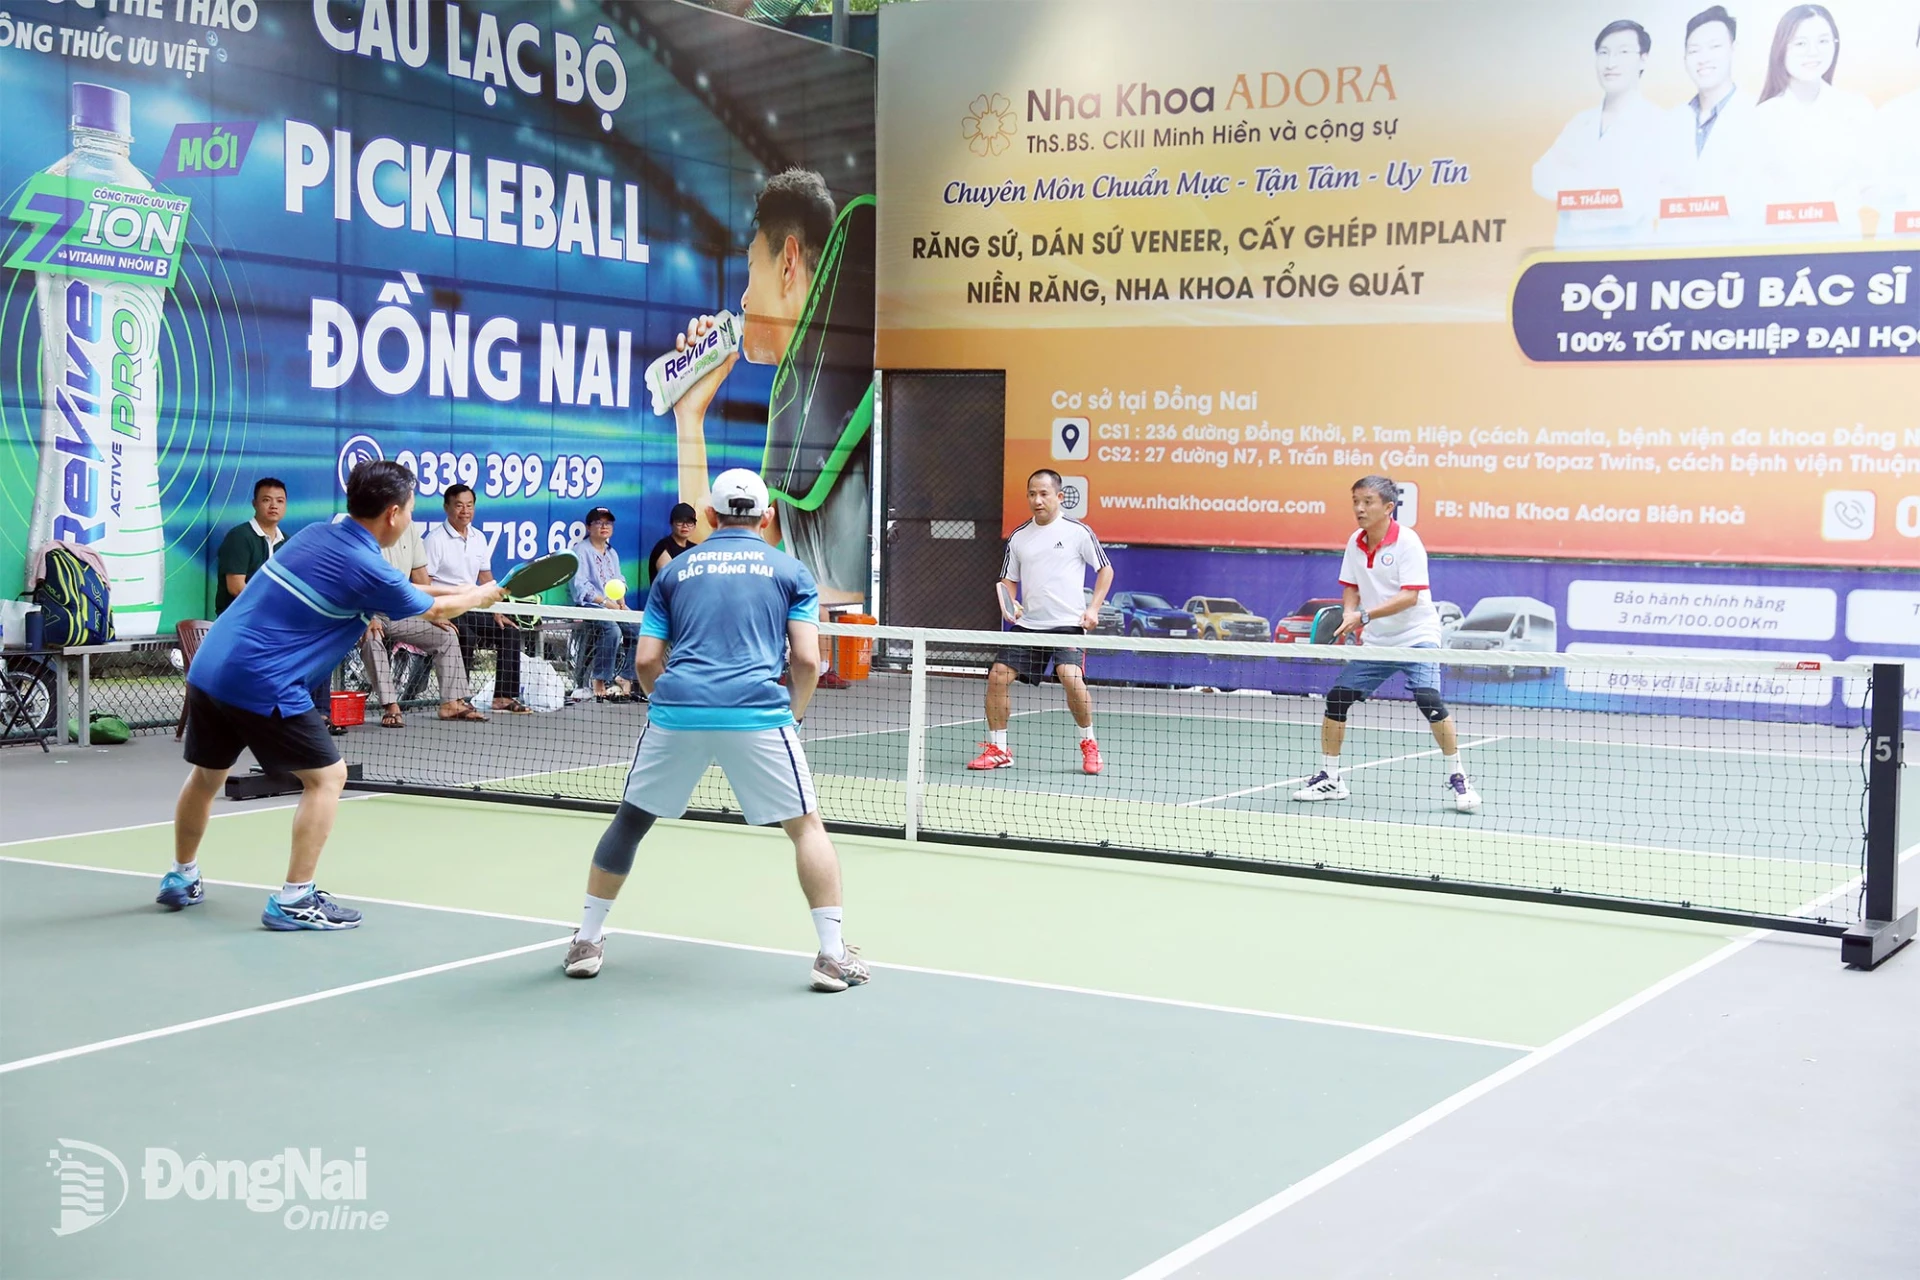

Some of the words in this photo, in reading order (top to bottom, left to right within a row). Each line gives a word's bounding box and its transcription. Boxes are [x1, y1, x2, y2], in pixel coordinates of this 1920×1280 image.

[59, 26, 123, 62] THỨC
[128, 37, 157, 66] ƯU
[163, 39, 210, 79] VIỆT
[447, 4, 542, 106] LẠC
[555, 24, 627, 131] BỘ
[1027, 88, 1101, 122] Nha
[1116, 82, 1215, 117] Khoa
[1225, 64, 1397, 111] ADORA
[177, 127, 238, 172] MỚI
[1027, 132, 1095, 154] ThS.BS.
[1103, 130, 1145, 150] CKII
[1154, 127, 1204, 147] Minh
[1213, 120, 1261, 144] Hiền
[1269, 119, 1296, 141] và
[1305, 119, 1364, 143] cộng
[1372, 118, 1398, 140] sự
[94, 187, 121, 201] CÔNG
[124, 194, 149, 206] THỨC
[167, 200, 187, 213] VIỆT
[285, 119, 649, 263] PICKLEBALL
[944, 179, 1026, 208] Chuyên
[1033, 177, 1084, 201] Môn
[1092, 168, 1169, 199] Chuẩn
[1176, 171, 1230, 199] Mực
[1255, 168, 1298, 197] Tận
[1307, 165, 1360, 190] Tâm
[1387, 161, 1422, 191] Uy
[1431, 159, 1469, 184] Tín
[23, 192, 86, 263] 7
[81, 202, 182, 255] ION
[912, 231, 980, 259] RĂNG
[987, 228, 1022, 261] SỨ,
[1032, 226, 1083, 256] DÁN
[1092, 225, 1124, 254] SỨ
[1131, 229, 1229, 255] VENEER,
[1239, 216, 1295, 250] CẤY
[1304, 217, 1377, 249] GHÉP
[1387, 219, 1506, 245] IMPLANT
[68, 250, 115, 267] VITAMIN
[118, 255, 154, 272] NHÓM
[155, 259, 168, 276] B
[967, 270, 1020, 303] NIỀN
[1029, 275, 1106, 306] RĂNG,
[1116, 277, 1169, 301] NHA
[1180, 276, 1254, 300] KHOA
[1263, 261, 1339, 298] TỔNG
[1349, 265, 1424, 296] QUÁT
[1561, 274, 1637, 320] ĐỘI
[1651, 271, 1745, 310] NGŨ
[1758, 266, 1855, 307] BÁC
[1867, 265, 1912, 305] SĨ
[307, 271, 522, 402] ĐỒNG
[539, 321, 632, 407] NAI
[1556, 331, 1627, 352] 100%
[1633, 322, 1685, 351] TỐT
[1691, 322, 1800, 355] NGHIỆP
[1806, 326, 1860, 354] ĐẠI
[1869, 325, 1920, 353] HỌ
[111, 308, 142, 441] PRO
[1051, 389, 1082, 410] Cơ
[1088, 386, 1113, 410] sở
[1118, 390, 1147, 415] tại
[1153, 385, 1212, 415] Đồng
[1219, 390, 1258, 410] Nai
[1098, 424, 1130, 440] CS1
[1145, 424, 1177, 440] 236
[1182, 425, 1240, 445] đường
[1245, 420, 1294, 445] Đồng
[1300, 423, 1346, 444] Khởi,
[1352, 426, 1367, 442] P.
[1372, 426, 1411, 442] Tam
[1417, 425, 1463, 447] Hiệp
[1469, 426, 1529, 447] (cách
[1535, 427, 1612, 447] Amata,
[1618, 426, 1672, 449] bệnh
[1679, 426, 1725, 450] viện
[1731, 428, 1762, 445] đa
[1768, 428, 1826, 445] khoa
[485, 453, 543, 498] 399
[549, 455, 604, 498] 439
[1098, 446, 1131, 462] CS2
[1145, 447, 1165, 462] 27
[1171, 447, 1228, 467] đường
[1233, 449, 1263, 467] N7,
[1268, 449, 1282, 465] P.
[1288, 446, 1327, 465] Trấn
[1334, 447, 1373, 466] Biên
[1380, 445, 1429, 470] (Gần
[1435, 451, 1497, 473] chung
[1503, 453, 1530, 468] cư
[1534, 452, 1594, 473] Topaz
[1600, 453, 1661, 474] Twins,
[1668, 452, 1724, 472] cách
[1730, 452, 1787, 477] bệnh
[1794, 452, 1842, 477] viện
[110, 441, 122, 518] ACTIVE
[1100, 493, 1326, 514] www.nhakhoaadora.com
[1435, 500, 1463, 518] FB:
[1469, 501, 1509, 519] Nha
[1516, 502, 1569, 521] Khoa
[1575, 503, 1640, 522] Adora
[1646, 504, 1693, 524] Biên
[687, 551, 765, 564] AGRIBANK
[750, 564, 774, 577] NAI
[1613, 590, 1644, 605] Bảo
[1648, 592, 1689, 606] hành
[1694, 593, 1739, 608] chính
[1618, 612, 1627, 624] 3
[1608, 673, 1648, 688] 80%
[1875, 736, 1892, 762] 5
